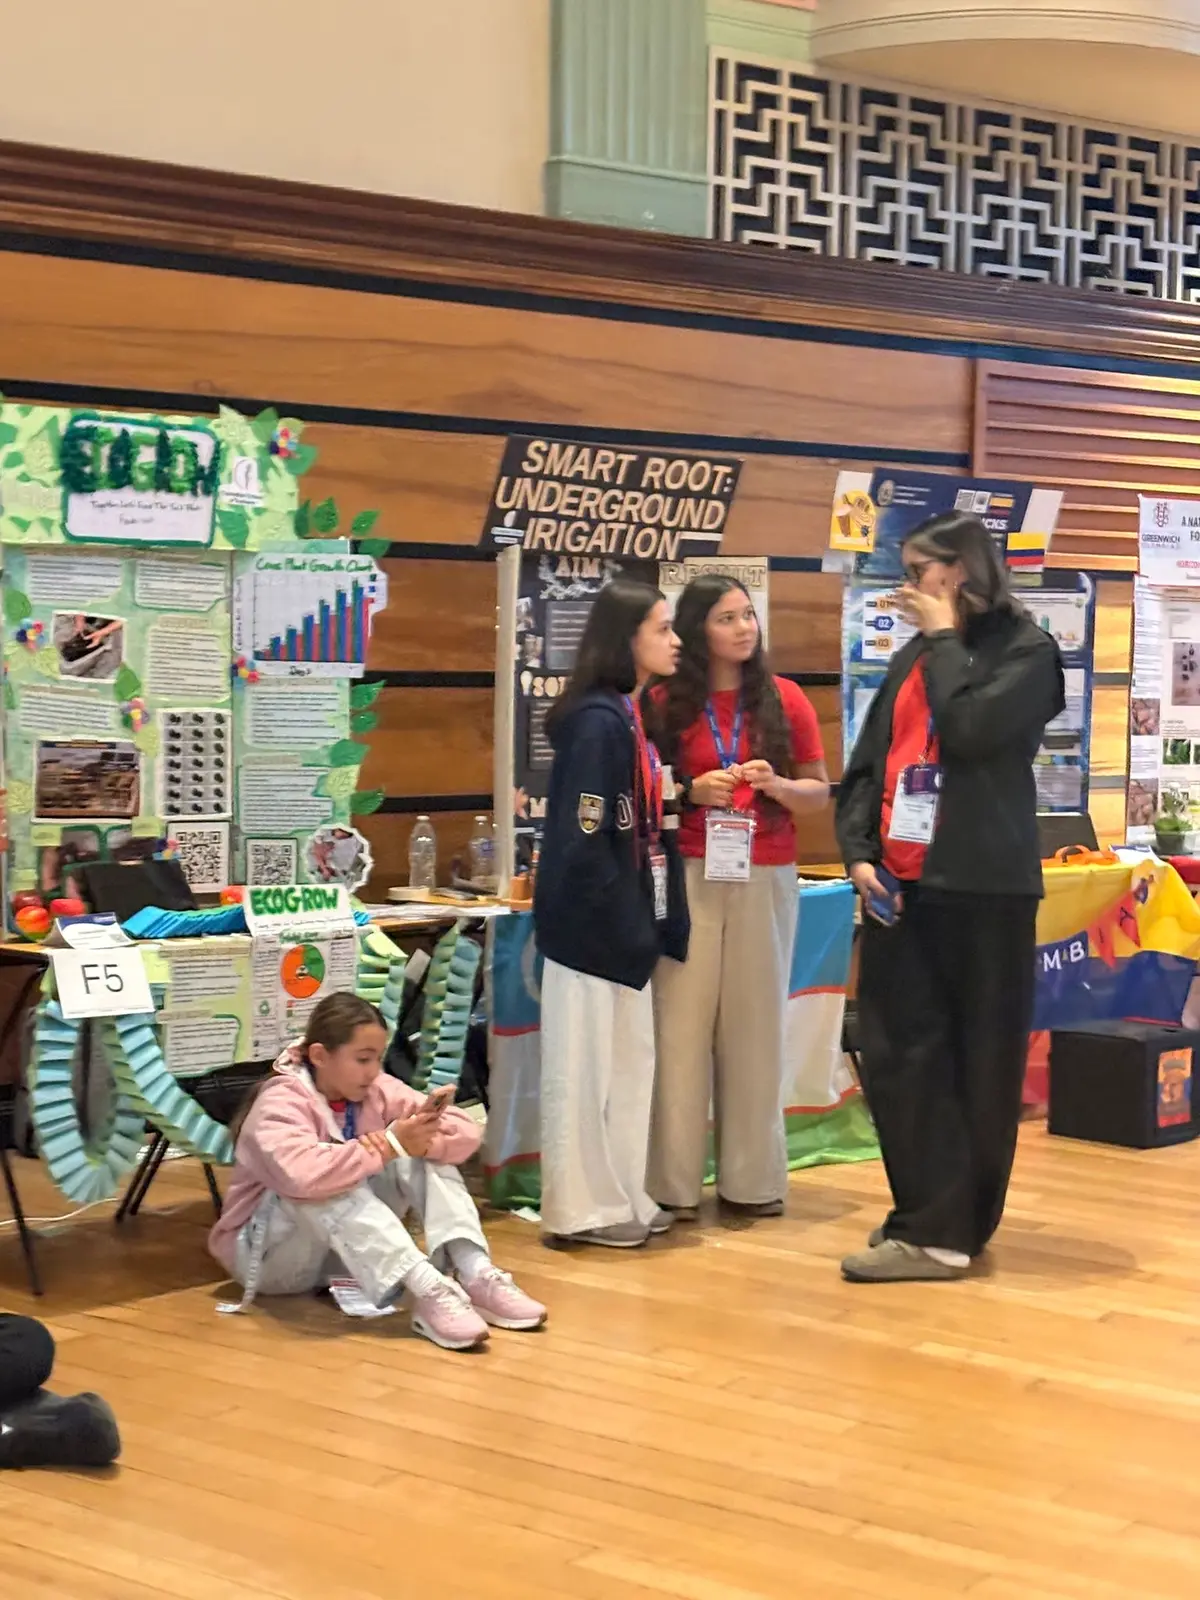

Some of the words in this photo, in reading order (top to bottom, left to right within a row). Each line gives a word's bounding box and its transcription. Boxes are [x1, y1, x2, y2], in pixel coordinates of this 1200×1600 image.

[522, 440, 637, 485] SMART
[641, 457, 734, 496] ROOT:
[495, 476, 725, 531] UNDERGROUND
[523, 517, 682, 561] IRIGATION
[1141, 533, 1181, 544] GREENWICH
[555, 554, 601, 579] AIM
[250, 887, 339, 917] ECOGROW
[81, 963, 124, 995] F5
